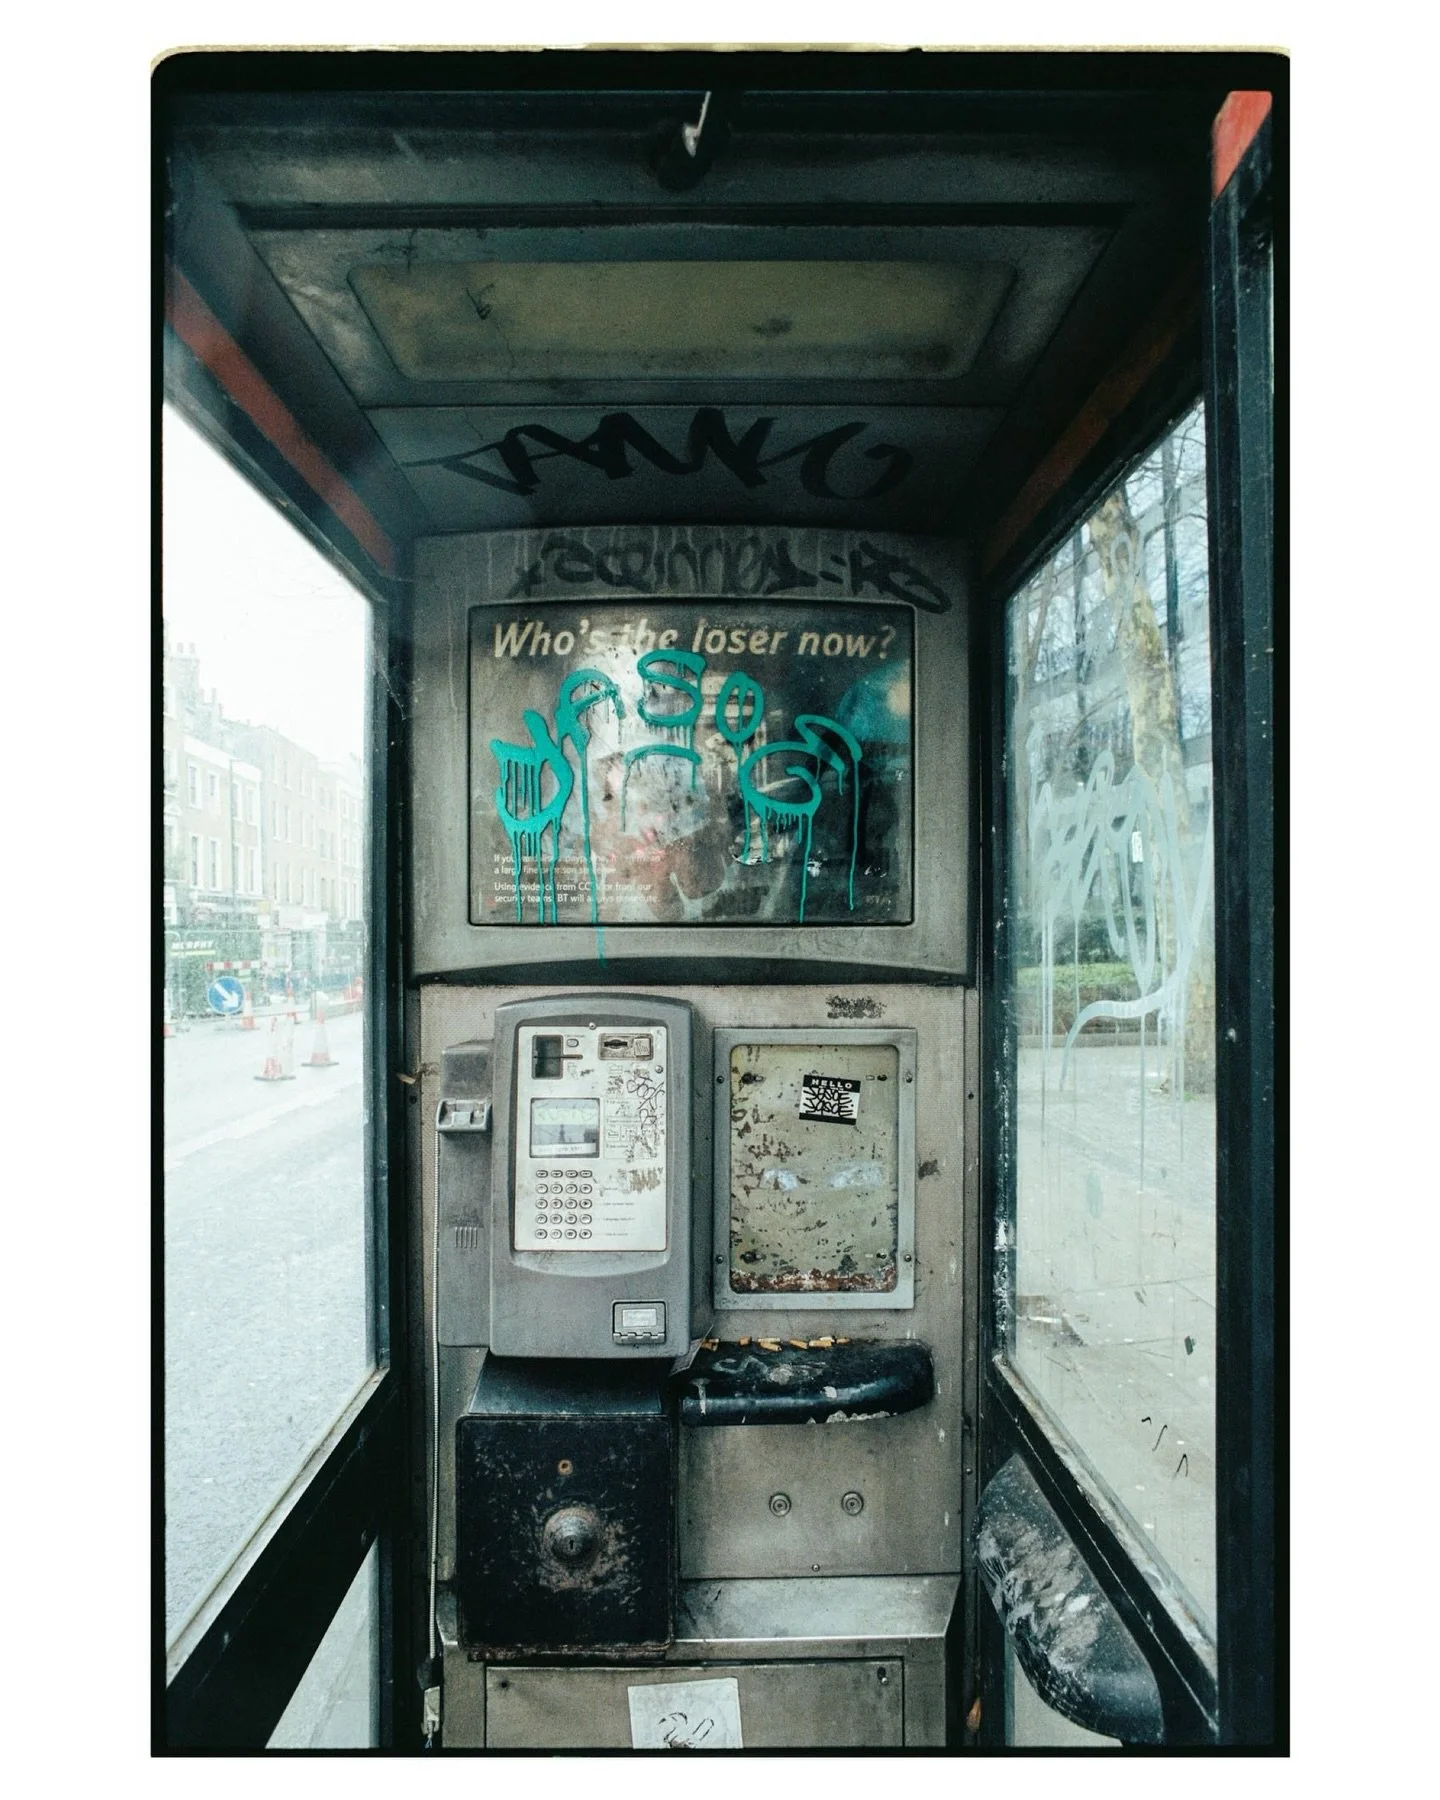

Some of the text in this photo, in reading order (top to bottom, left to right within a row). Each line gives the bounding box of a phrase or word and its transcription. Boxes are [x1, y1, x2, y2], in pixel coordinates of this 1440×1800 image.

[494, 619, 604, 657] Who's
[691, 619, 788, 655] loser
[797, 625, 898, 660] now?
[501, 866, 520, 877] larg
[494, 882, 517, 892] Using
[519, 882, 556, 891] evidec
[557, 882, 576, 891] from
[494, 894, 525, 904] securiy
[557, 894, 569, 902] BT
[570, 894, 584, 902] will
[811, 1079, 853, 1089] HELLO
